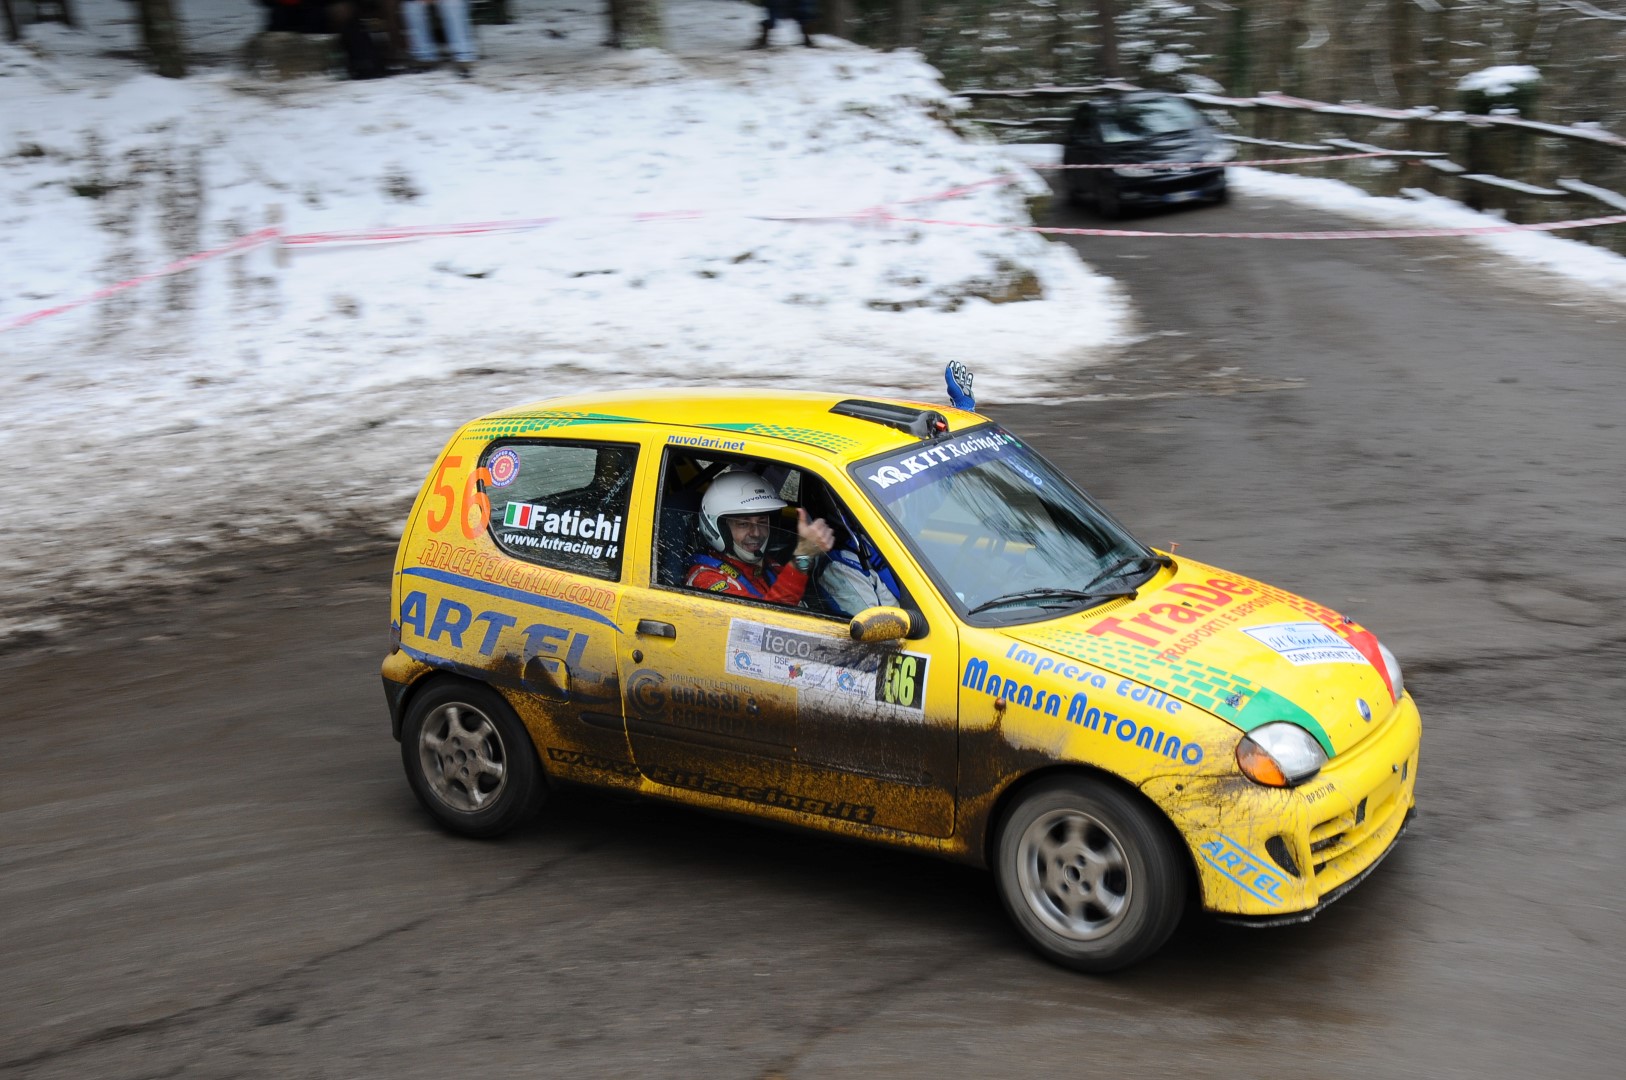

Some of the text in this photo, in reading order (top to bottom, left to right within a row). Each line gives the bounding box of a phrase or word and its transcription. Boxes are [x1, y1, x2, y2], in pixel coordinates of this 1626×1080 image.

[667, 433, 745, 451] nuvolari.net
[900, 445, 951, 475] KIT
[427, 456, 492, 540] 56
[529, 504, 622, 542] Fatichi
[391, 590, 602, 685] ARTEL
[765, 630, 811, 658] teco
[1154, 618, 1230, 663] TRASPORTI
[884, 654, 917, 707] 56
[1005, 643, 1182, 715] Impresa Edile
[1201, 841, 1284, 903] ARTEL
